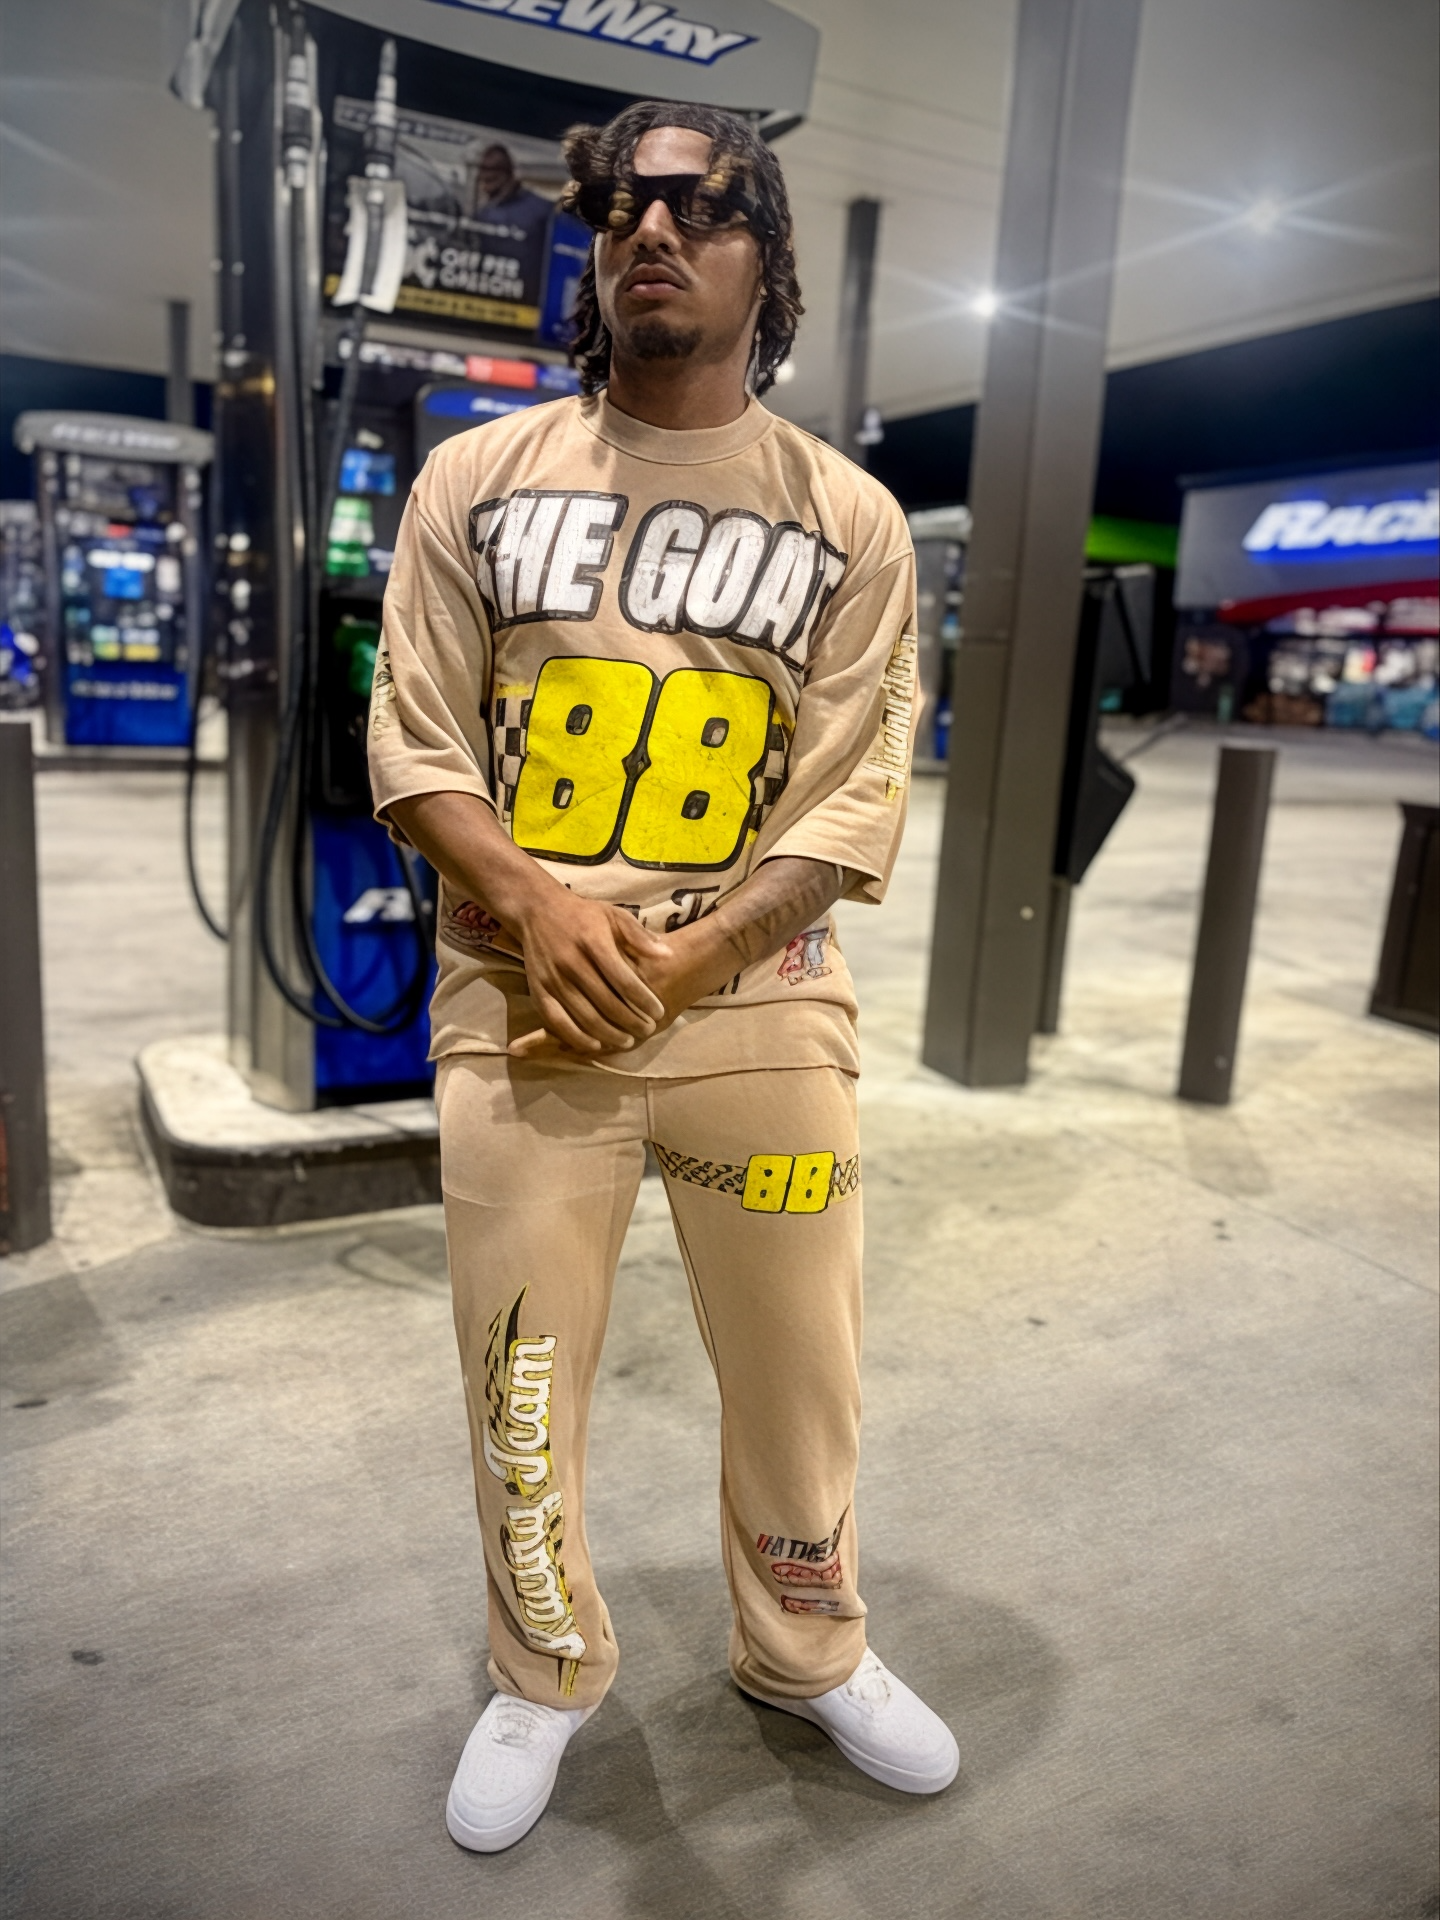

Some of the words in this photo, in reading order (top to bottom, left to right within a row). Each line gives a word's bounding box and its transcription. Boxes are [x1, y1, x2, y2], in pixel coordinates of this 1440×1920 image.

[452, 0, 750, 61] EWAY
[470, 489, 628, 632] THE
[511, 656, 776, 872] 88
[741, 1151, 836, 1214] 88
